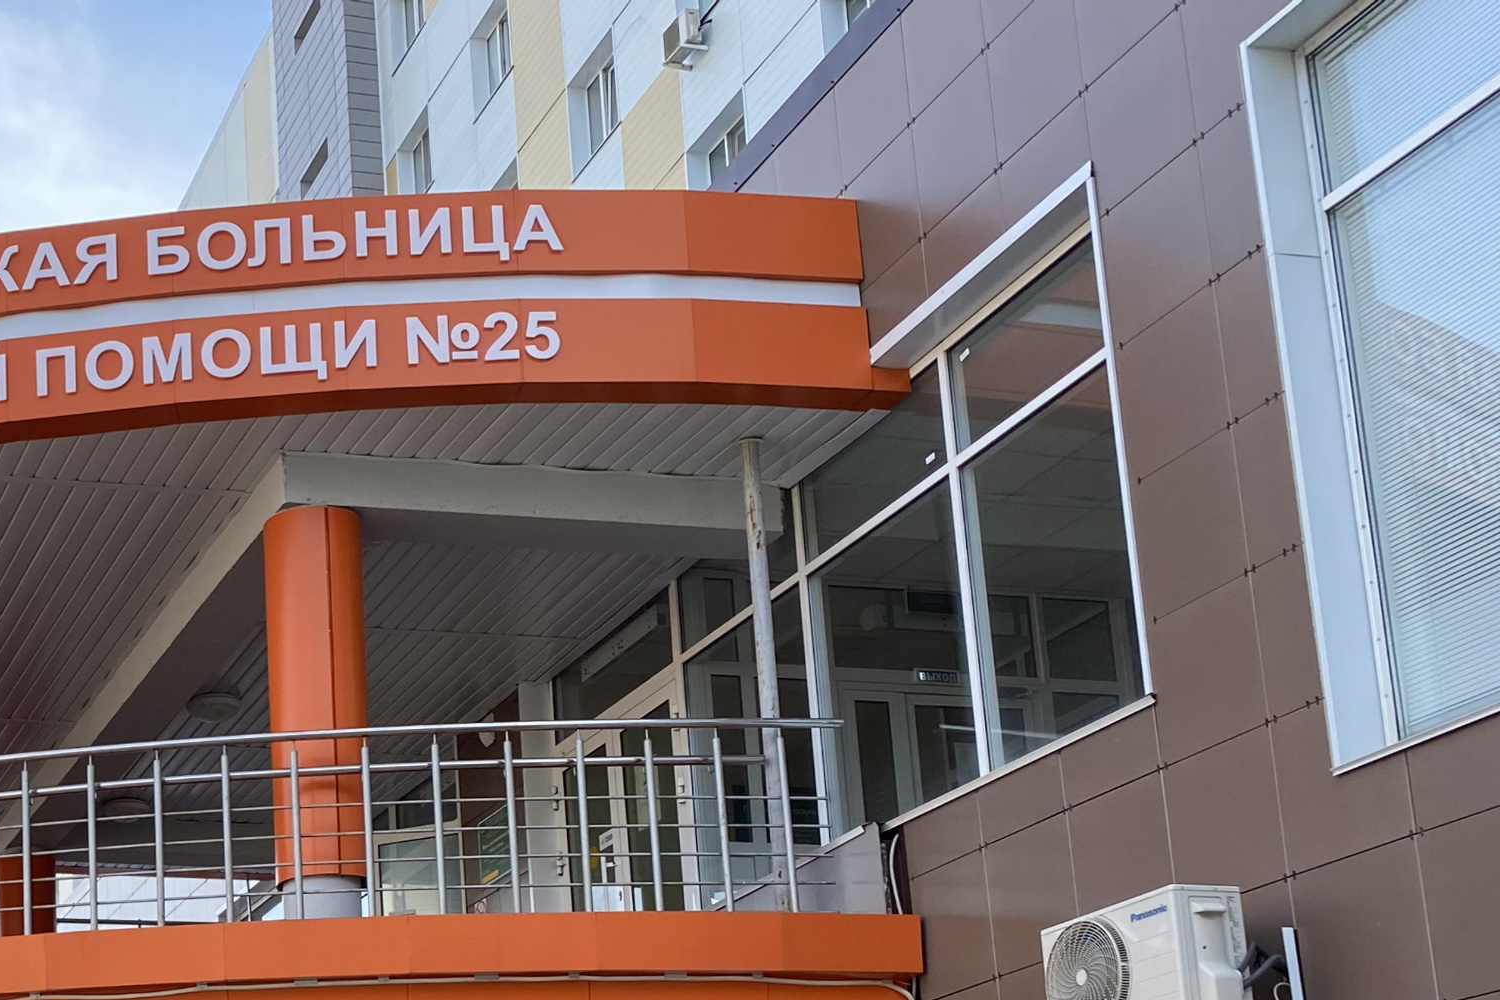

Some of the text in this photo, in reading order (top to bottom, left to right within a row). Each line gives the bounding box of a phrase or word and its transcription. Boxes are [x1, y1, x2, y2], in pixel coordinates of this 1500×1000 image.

[145, 203, 565, 276] БОЛЬНИЦА
[34, 318, 378, 397] ПОМОЩИ
[405, 310, 561, 365] №25
[1130, 904, 1168, 923] Panasonic
